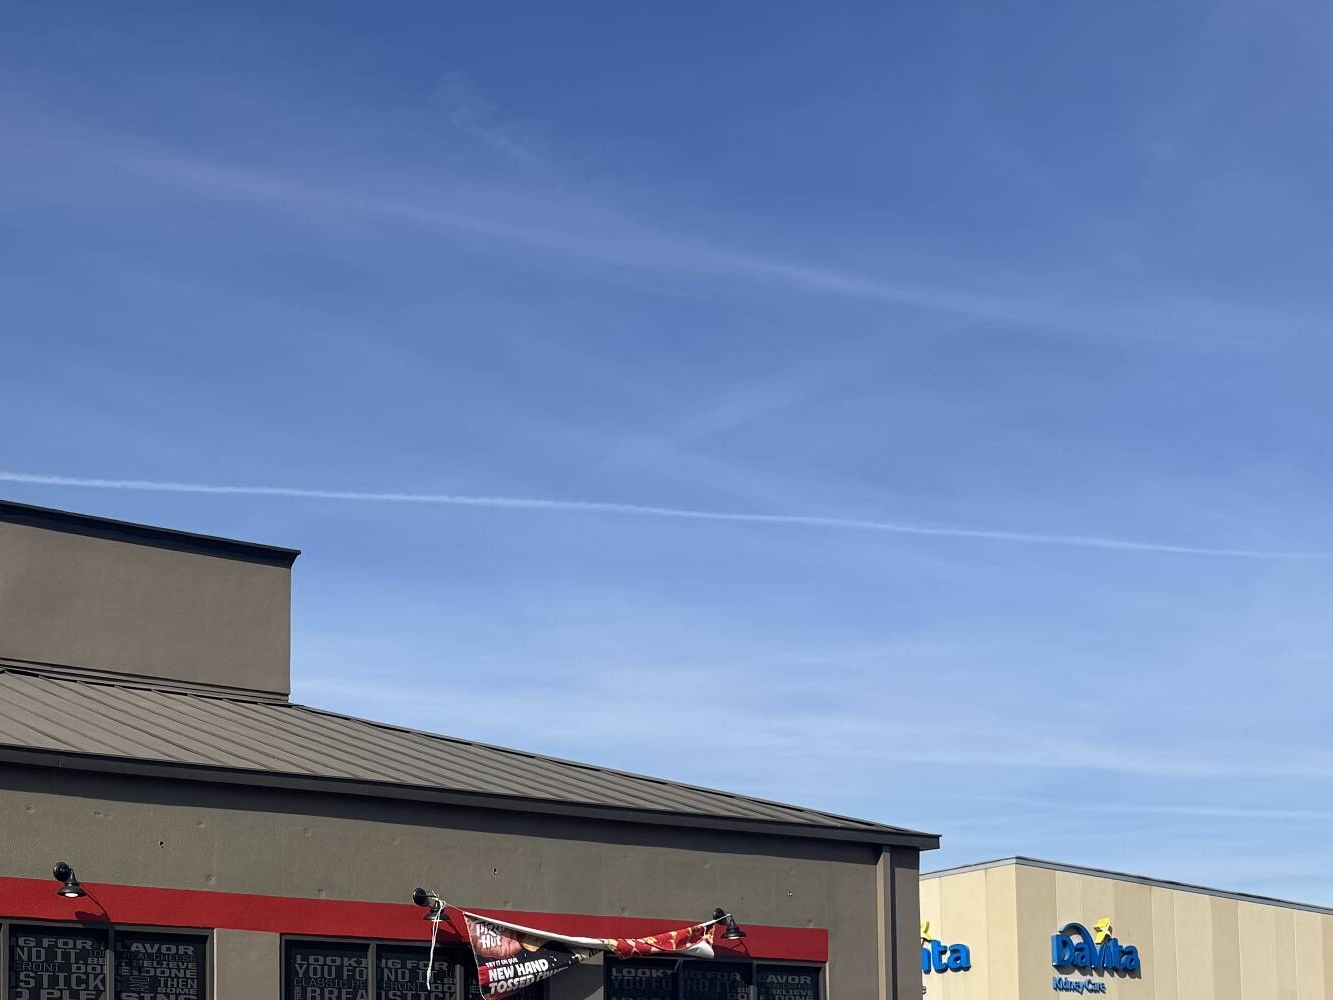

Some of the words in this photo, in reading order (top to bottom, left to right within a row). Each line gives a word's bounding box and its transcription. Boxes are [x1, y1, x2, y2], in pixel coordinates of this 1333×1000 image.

[42, 938, 93, 950] FOR
[479, 934, 502, 948] Hut
[1051, 922, 1140, 971] DaVita
[54, 949, 84, 964] IT.
[920, 939, 971, 973] ita
[295, 963, 336, 979] YOU
[343, 966, 409, 982] FOND
[488, 965, 515, 982] NEW
[515, 958, 549, 977] HAND
[157, 977, 197, 989] THEN
[489, 974, 535, 995] TOSSED
[1084, 979, 1106, 994] Care
